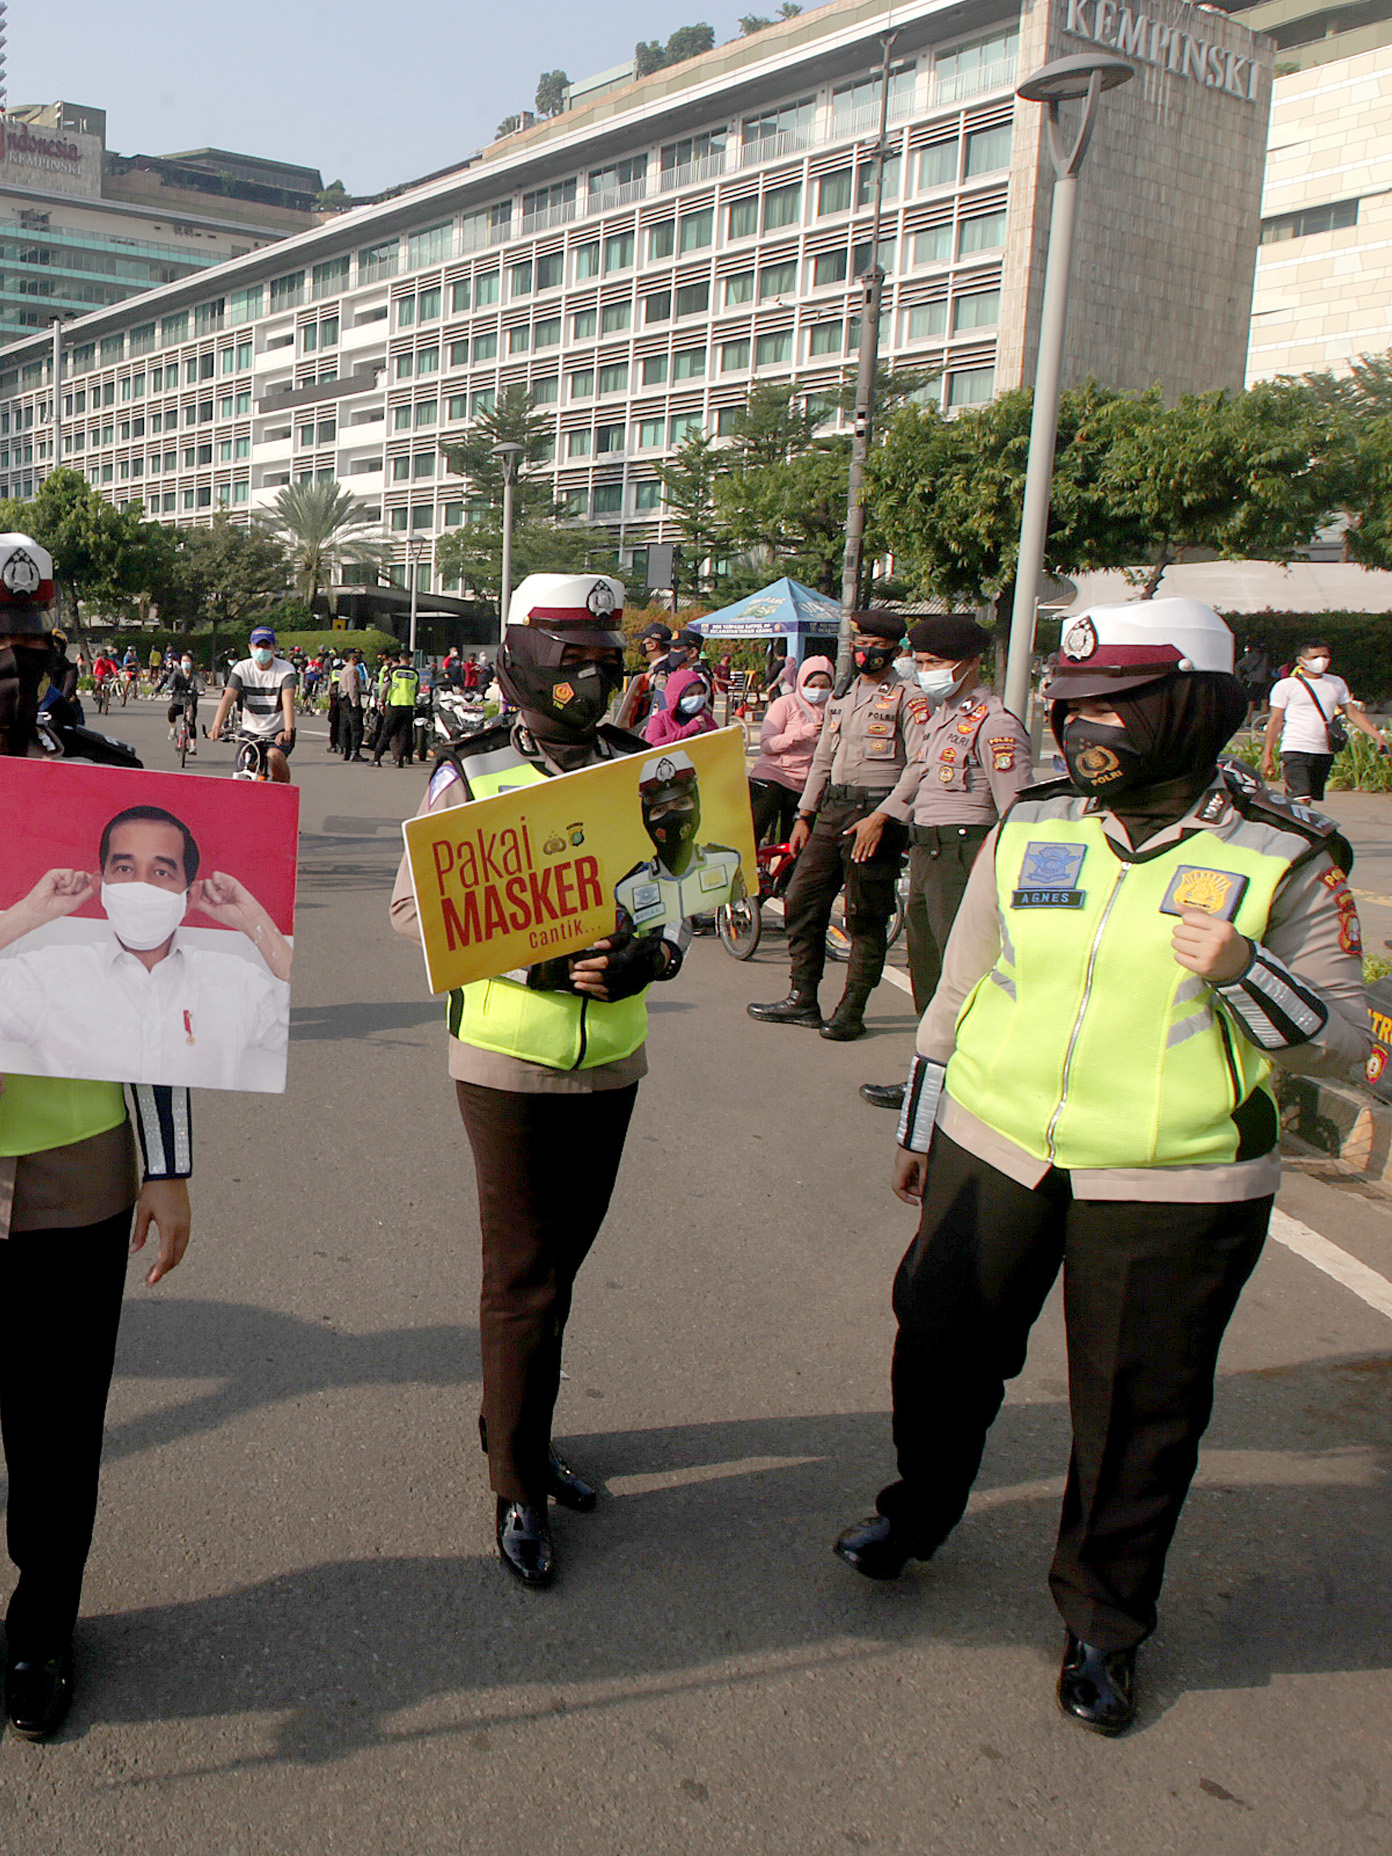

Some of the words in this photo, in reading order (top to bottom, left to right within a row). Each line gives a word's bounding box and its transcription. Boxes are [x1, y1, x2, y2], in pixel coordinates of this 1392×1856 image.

[1062, 0, 1258, 101] KEMPINSKI
[8, 151, 82, 175] KEMPINSKI
[946, 732, 970, 748] POLRI
[1090, 769, 1125, 787] POLRI
[432, 816, 533, 896] Pakai
[440, 855, 603, 951] MASKER
[1021, 892, 1070, 904] AGNES
